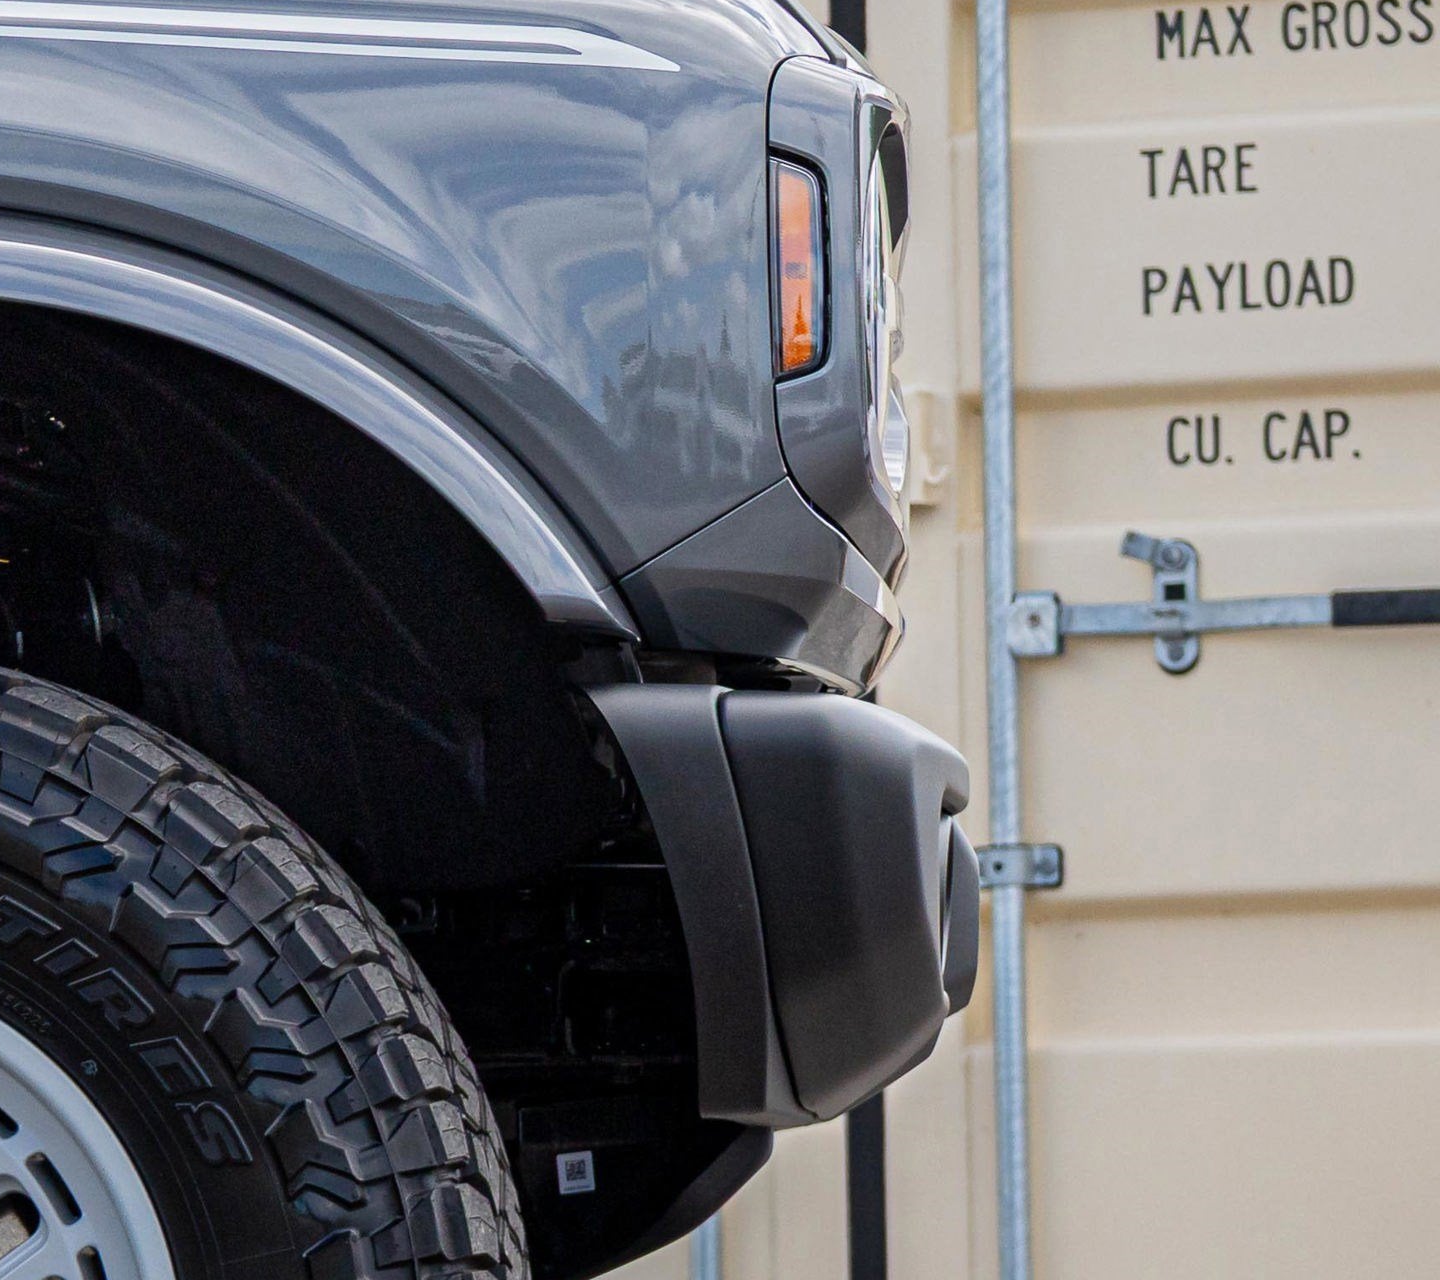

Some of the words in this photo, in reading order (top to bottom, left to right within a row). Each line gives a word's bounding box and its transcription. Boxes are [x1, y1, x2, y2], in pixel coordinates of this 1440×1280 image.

[1154, 4, 1254, 61] MAX
[1139, 142, 1258, 199] TARE
[1141, 256, 1355, 317] PAYLOAD
[1166, 414, 1234, 467] CU.
[1262, 408, 1361, 463] CAP.
